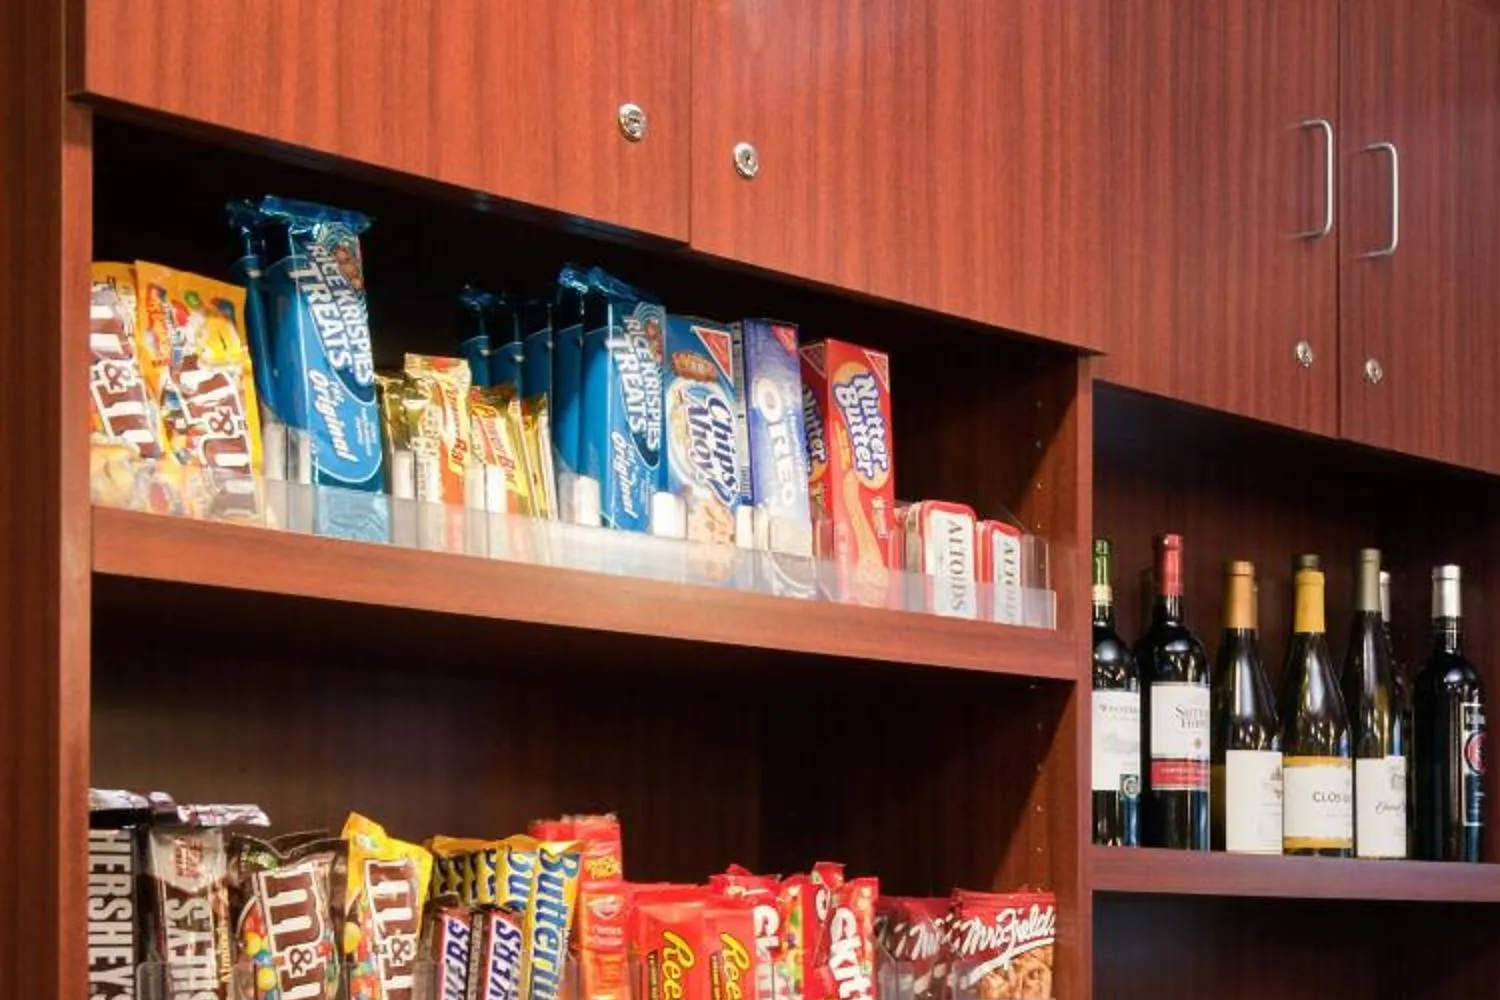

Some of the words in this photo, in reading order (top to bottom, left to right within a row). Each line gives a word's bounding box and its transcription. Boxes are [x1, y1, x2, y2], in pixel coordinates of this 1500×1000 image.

[289, 260, 353, 371] TREATS
[337, 287, 375, 387] KRISPIES
[605, 334, 648, 436] TREATS
[642, 360, 662, 451] KRISPIES
[833, 383, 874, 480] Butter
[852, 373, 888, 473] Nutter
[706, 397, 738, 492] Chips
[756, 377, 795, 507] OREO
